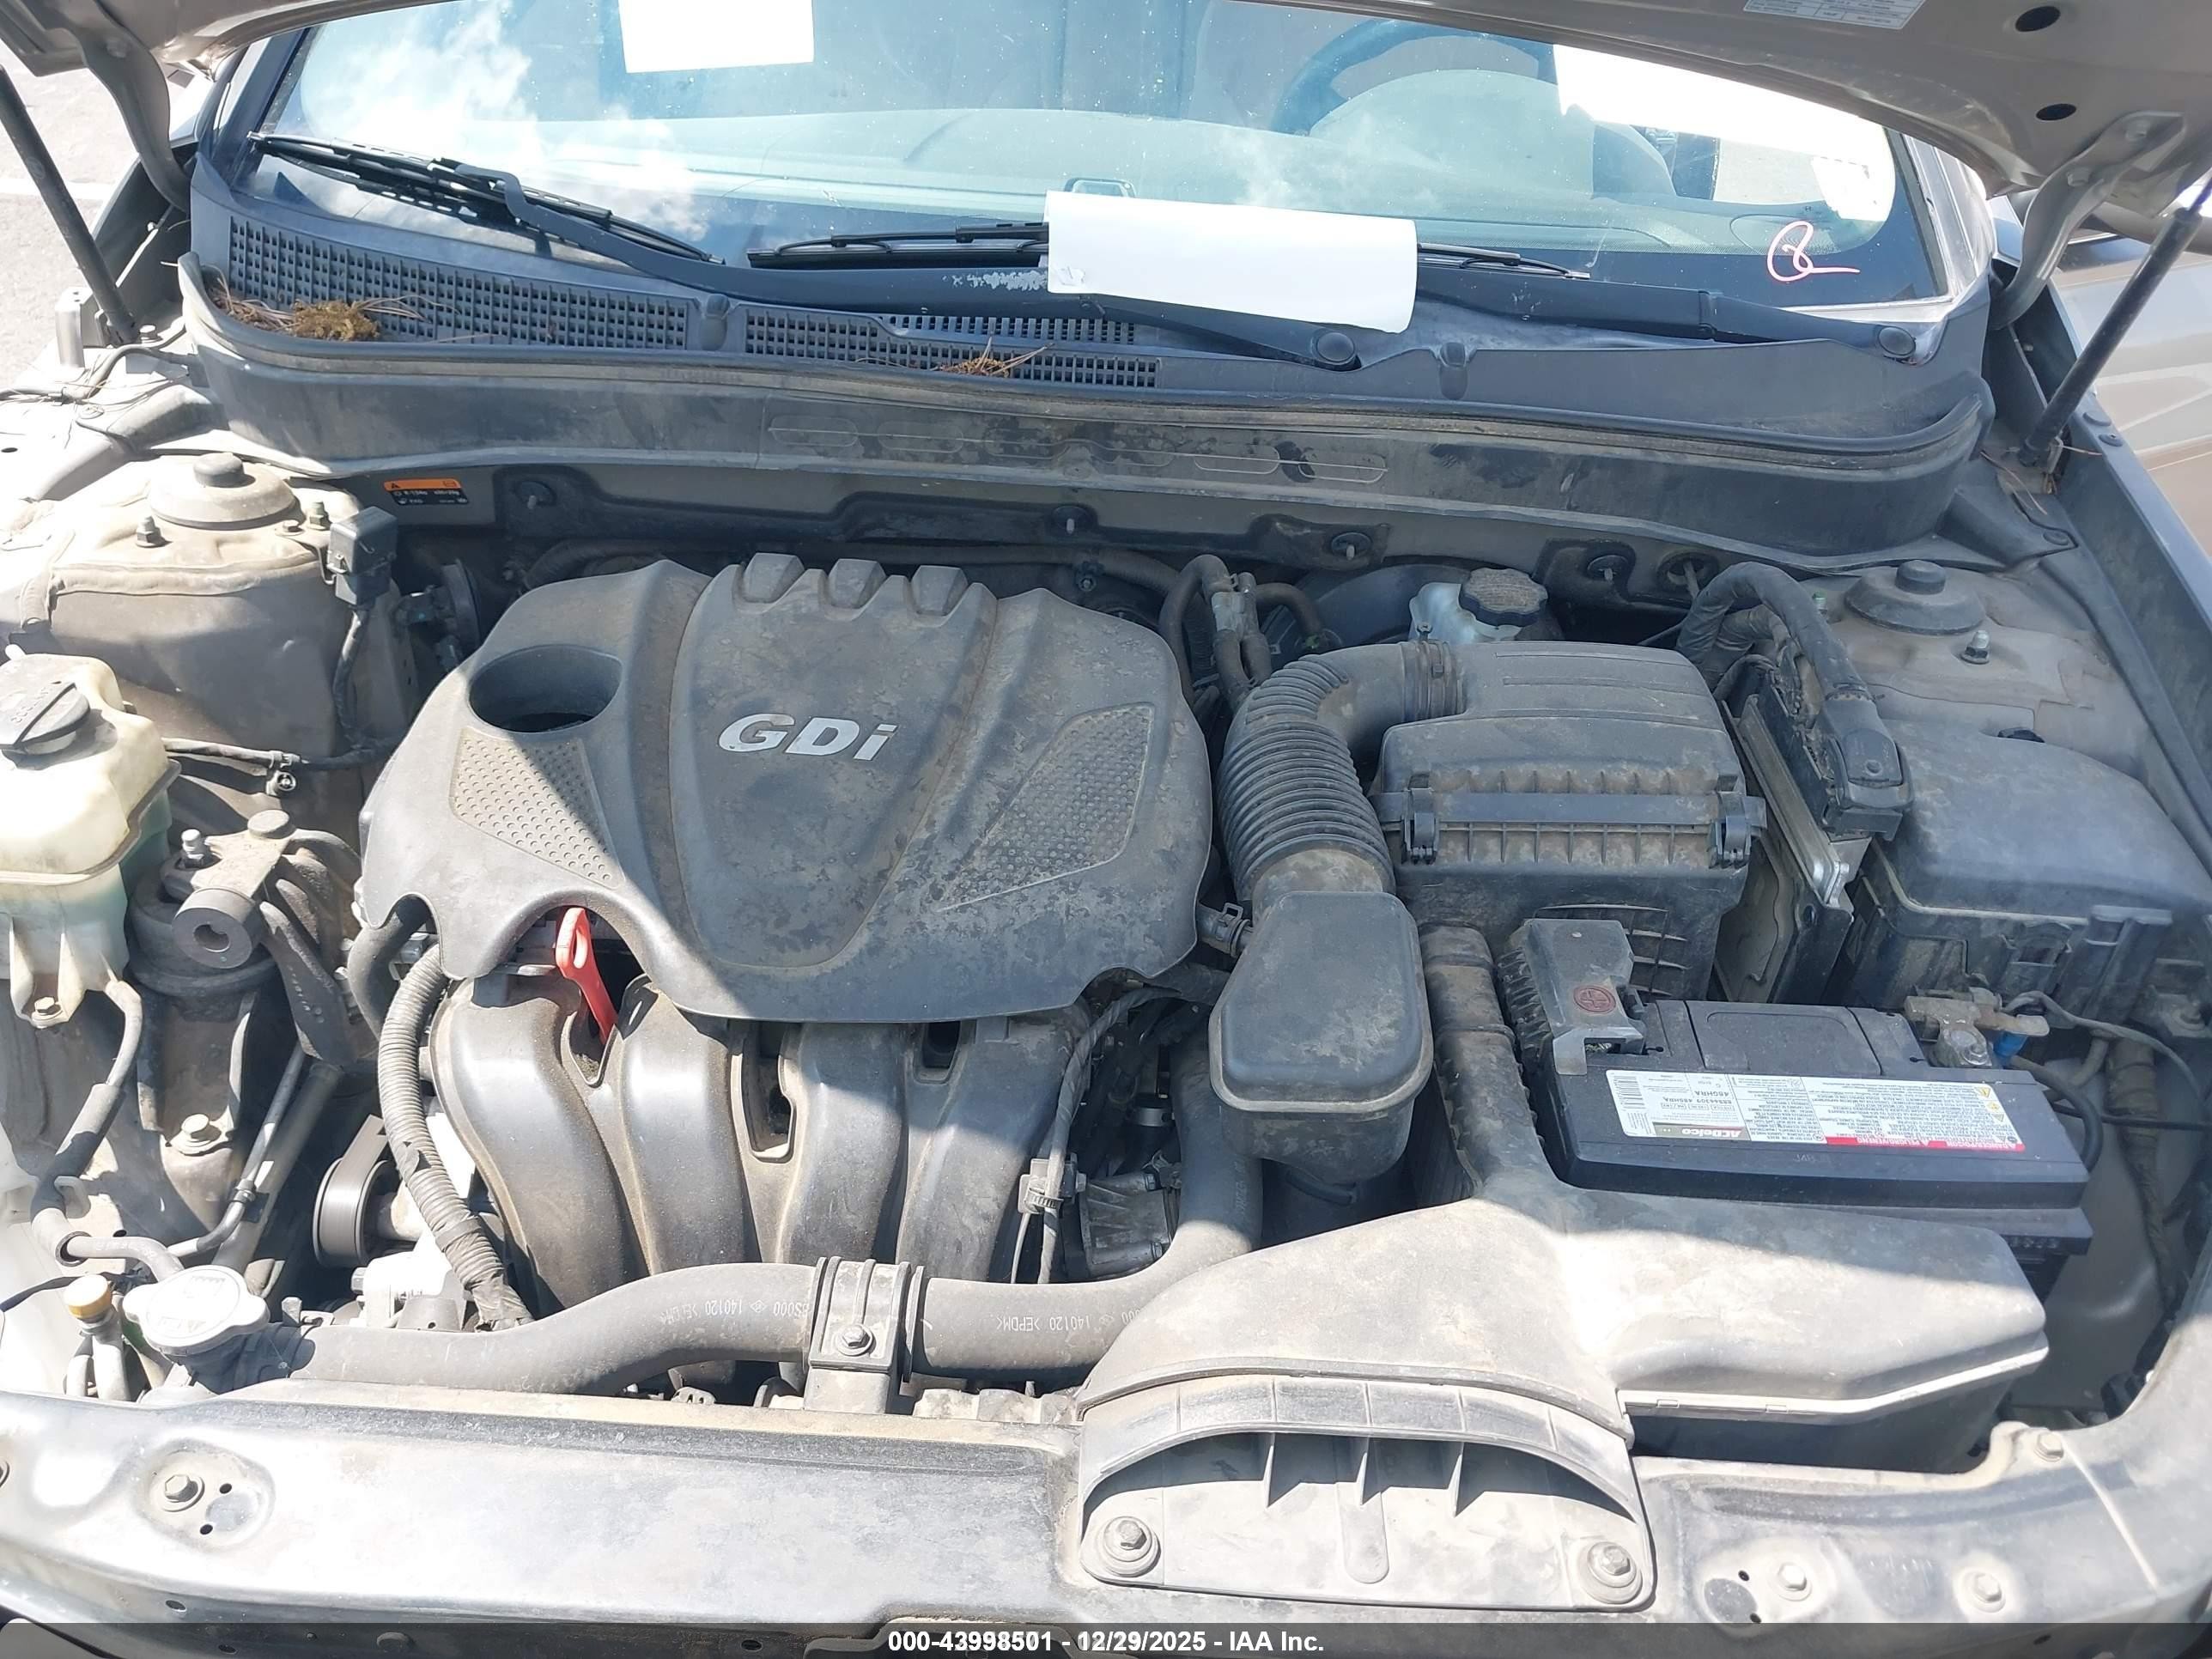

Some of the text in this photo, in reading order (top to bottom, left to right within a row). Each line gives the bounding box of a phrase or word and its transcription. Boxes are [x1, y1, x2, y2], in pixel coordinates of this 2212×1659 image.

[718, 713, 899, 761] GDi
[1681, 1127, 1742, 1138] ACDelco
[705, 1298, 743, 1316] 140120
[996, 1316, 1041, 1331] >EPDM<
[1049, 1316, 1091, 1331] 140120
